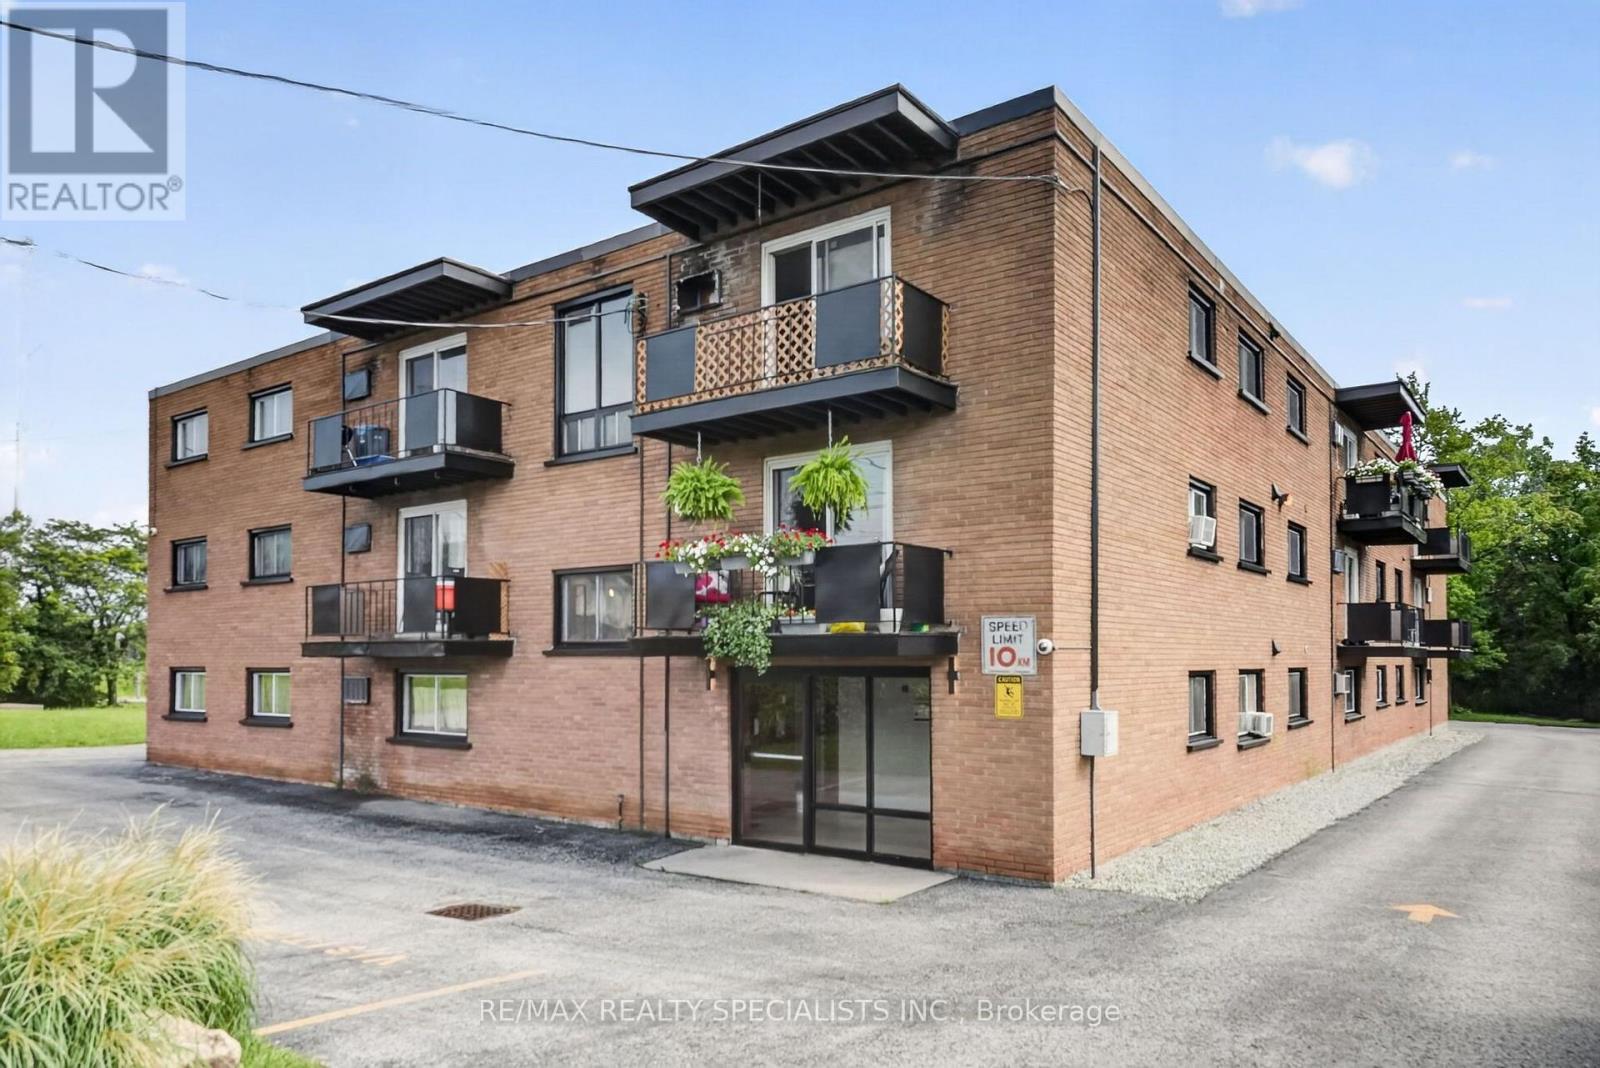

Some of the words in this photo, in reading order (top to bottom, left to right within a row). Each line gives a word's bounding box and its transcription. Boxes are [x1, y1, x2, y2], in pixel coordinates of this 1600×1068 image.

[988, 621, 1028, 632] SPEED
[992, 634, 1023, 645] LIMIT
[989, 646, 1017, 667] 10
